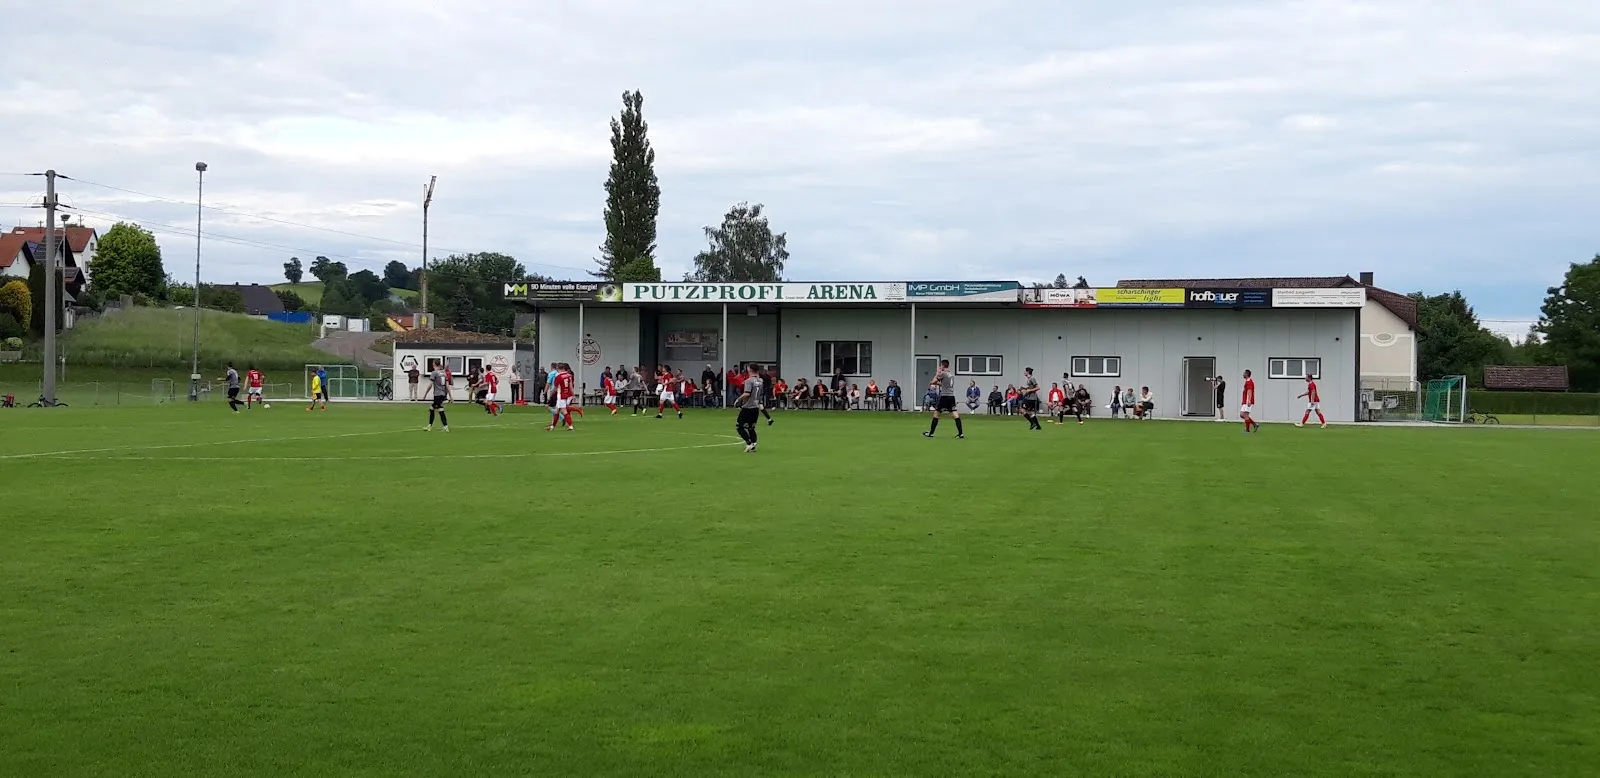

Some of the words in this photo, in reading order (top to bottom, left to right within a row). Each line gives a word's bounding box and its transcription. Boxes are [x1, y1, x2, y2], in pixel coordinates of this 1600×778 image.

[504, 283, 528, 296] MM
[576, 283, 598, 291] Energie!
[633, 285, 784, 300] PUTZPROFI
[806, 284, 878, 300] ARENA
[1190, 290, 1239, 301] hofbauer
